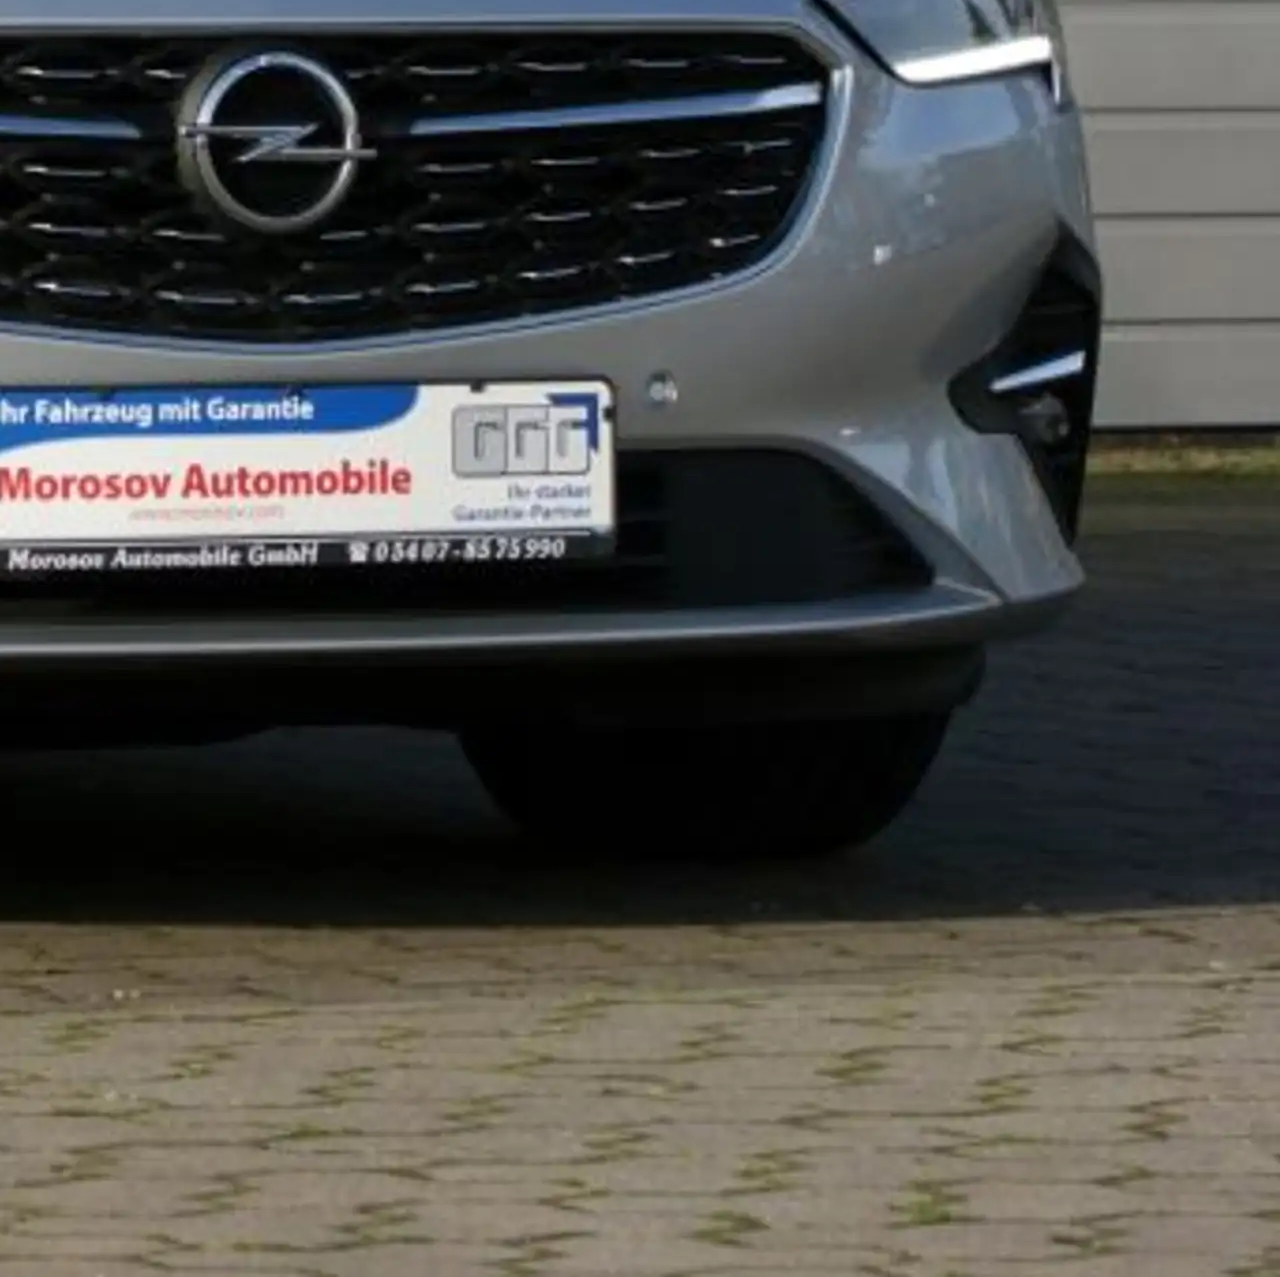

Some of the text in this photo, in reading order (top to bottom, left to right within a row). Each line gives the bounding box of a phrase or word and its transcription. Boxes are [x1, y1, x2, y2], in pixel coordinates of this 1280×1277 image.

[34, 397, 153, 428] Fahrzeug
[157, 396, 202, 423] mit
[206, 396, 315, 421] Garantie
[180, 457, 413, 499] Automobile
[8, 540, 320, 571] Morosov Automobile GmbH
